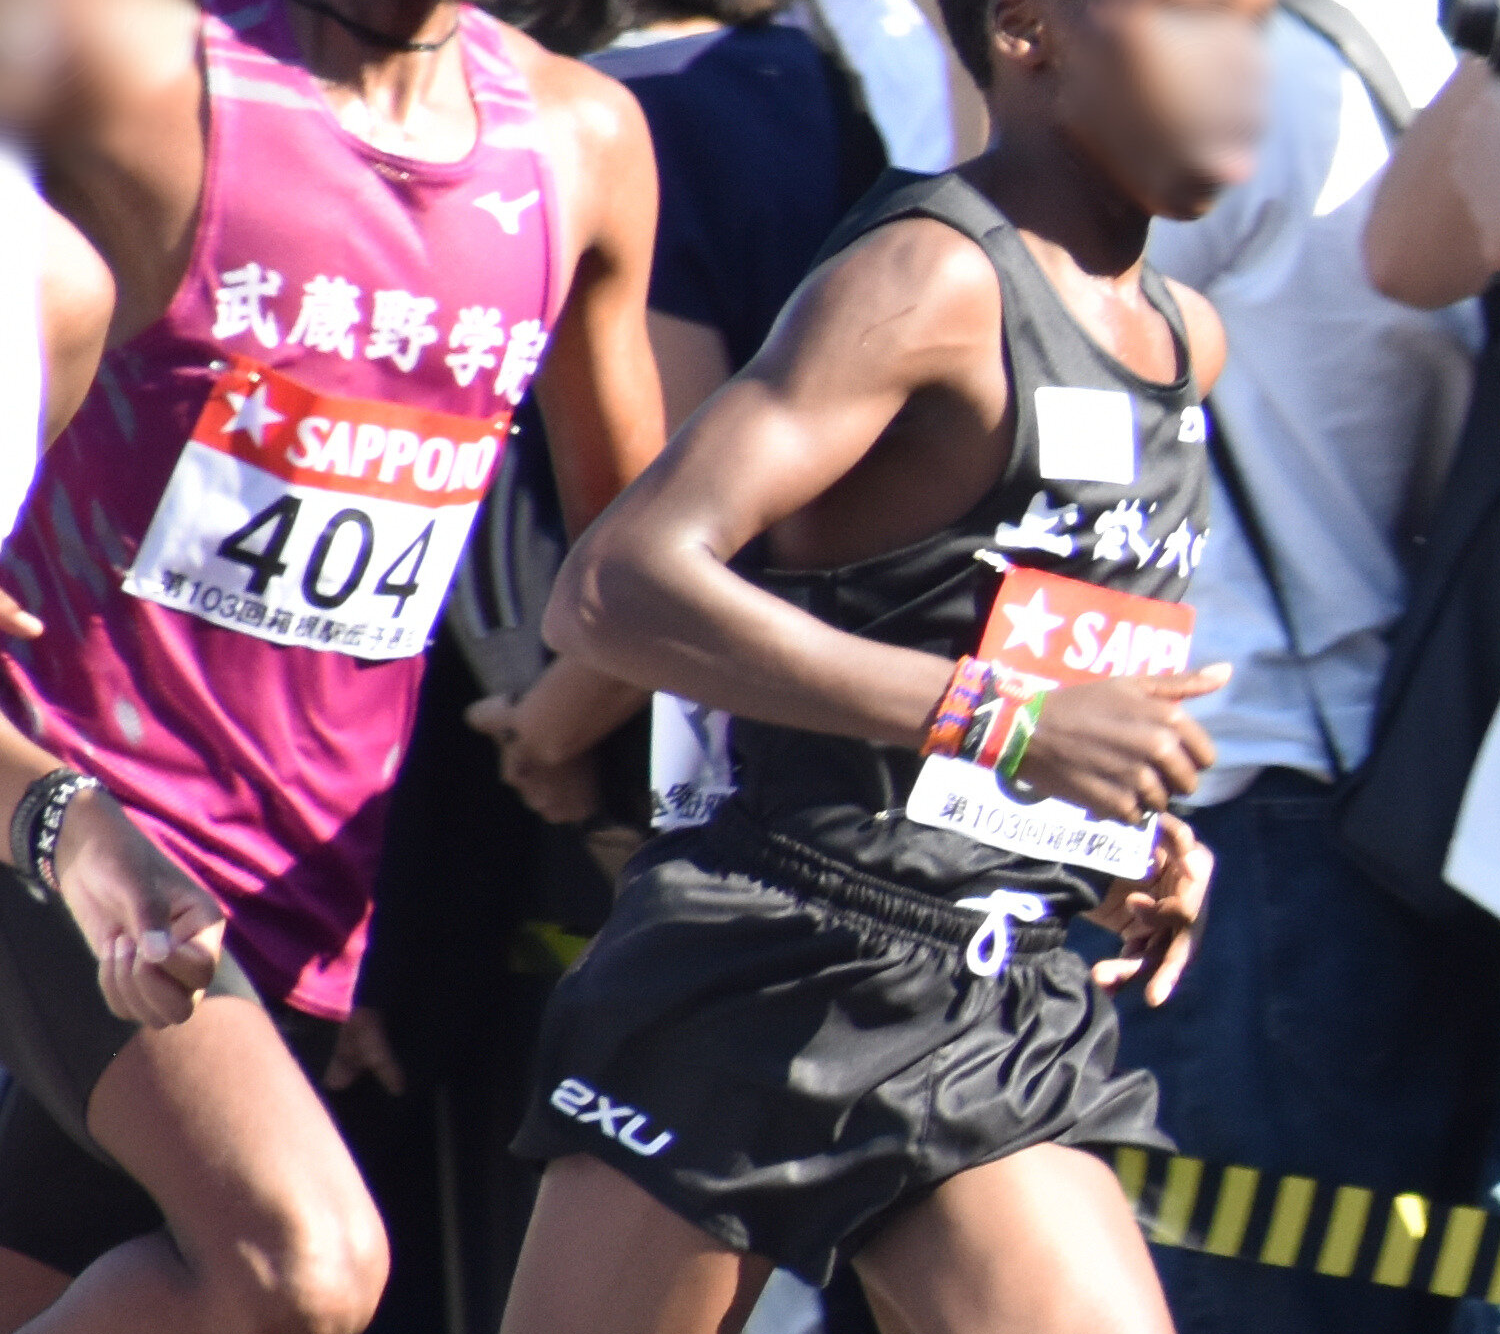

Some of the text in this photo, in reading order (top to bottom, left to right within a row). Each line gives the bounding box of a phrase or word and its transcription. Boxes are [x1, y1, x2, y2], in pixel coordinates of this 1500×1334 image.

[217, 493, 437, 619] 404
[1062, 611, 1194, 677] SAPP
[550, 1077, 674, 1157] 2XU
